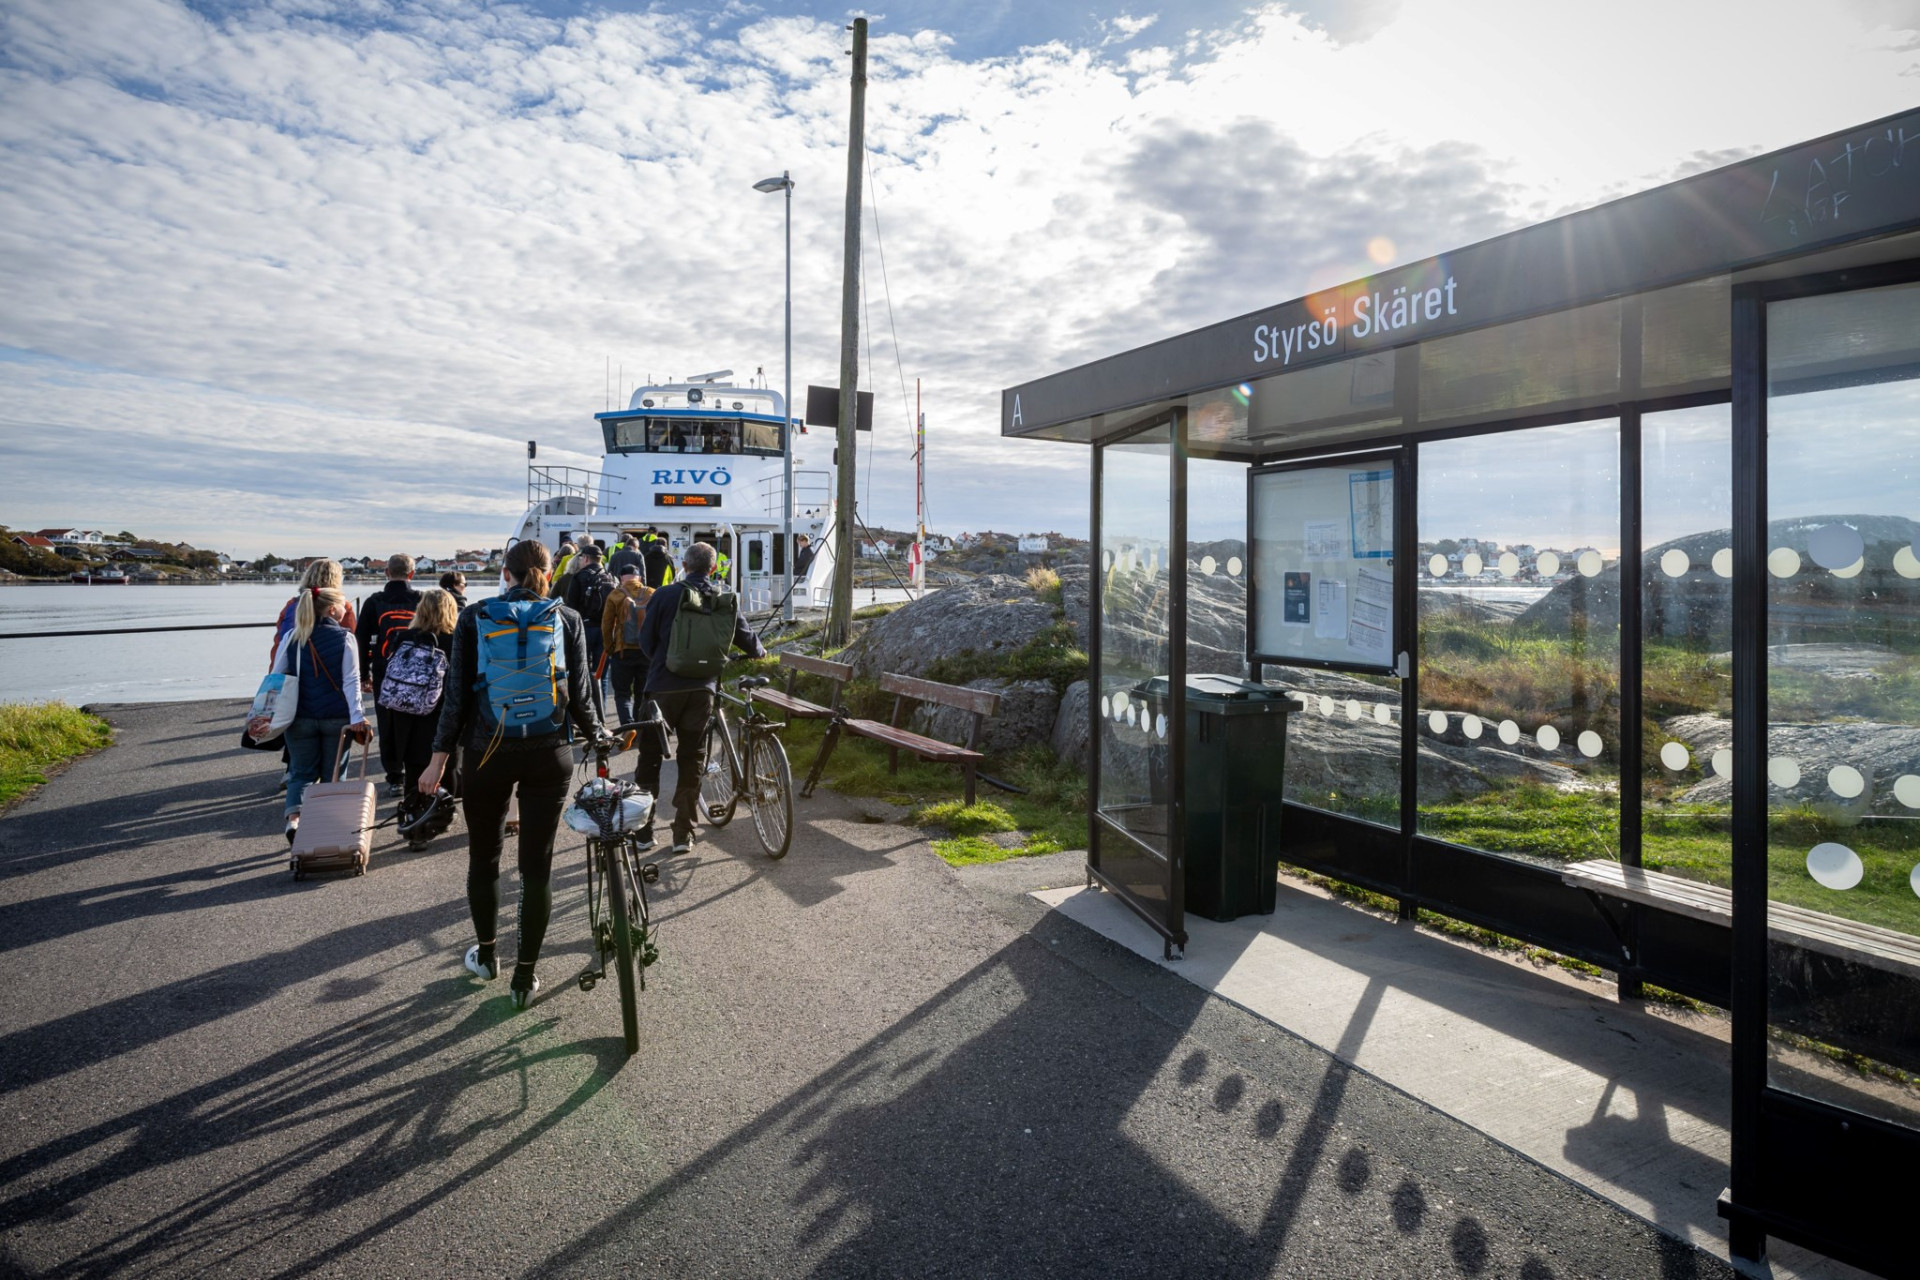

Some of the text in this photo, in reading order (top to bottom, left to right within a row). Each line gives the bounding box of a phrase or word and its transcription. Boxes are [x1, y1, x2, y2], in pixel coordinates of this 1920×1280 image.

[1254, 276, 1458, 365] Styrsö Skäret
[1011, 393, 1023, 427] A
[650, 466, 732, 486] RIVÖ
